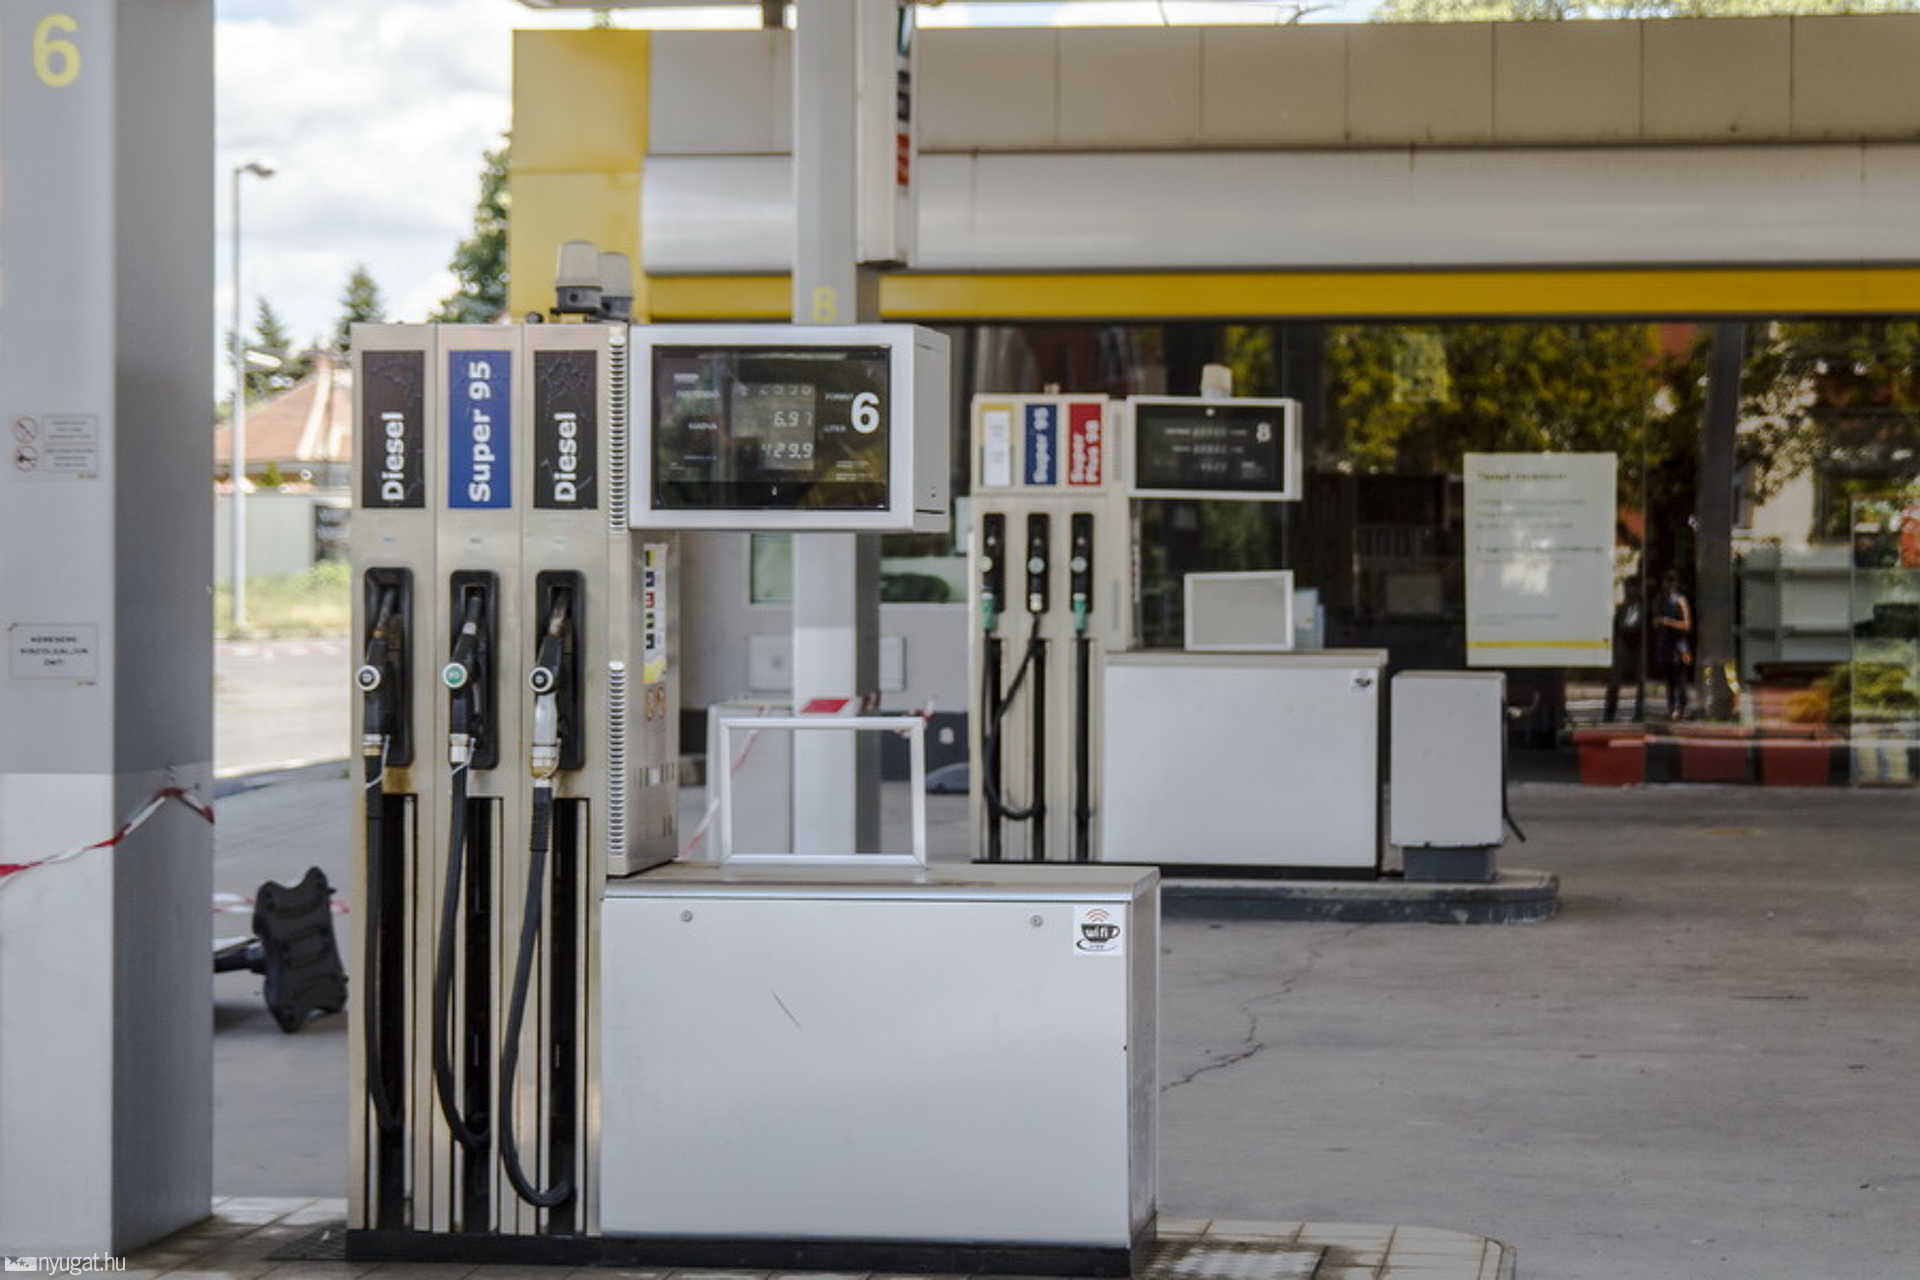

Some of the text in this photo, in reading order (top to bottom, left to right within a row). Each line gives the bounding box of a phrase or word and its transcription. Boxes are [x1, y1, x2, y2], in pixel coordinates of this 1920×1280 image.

[32, 13, 80, 87] 6
[381, 412, 405, 501] Diesel
[468, 360, 496, 502] Super 95
[554, 412, 577, 502] Diesel
[851, 391, 880, 434] 6
